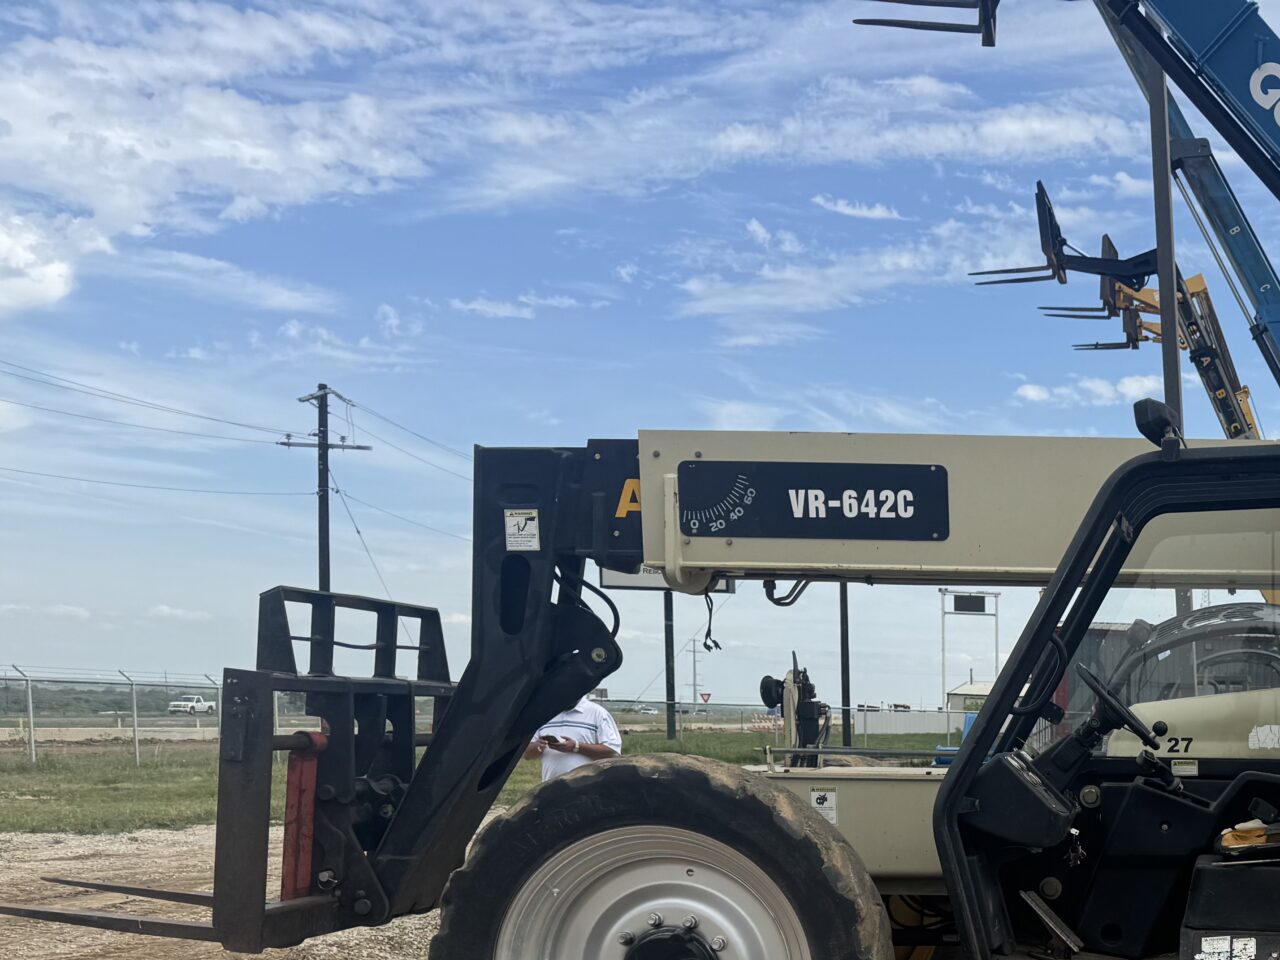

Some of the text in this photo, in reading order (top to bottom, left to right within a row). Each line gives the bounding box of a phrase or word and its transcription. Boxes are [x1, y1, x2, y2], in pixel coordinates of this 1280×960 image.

[1229, 225, 1241, 236] B
[1260, 284, 1271, 293] C
[1216, 388, 1226, 399] B
[614, 478, 641, 518] A
[788, 489, 915, 519] VR-642C
[690, 488, 756, 532] 0 20 40 60
[1166, 737, 1194, 753] 27
